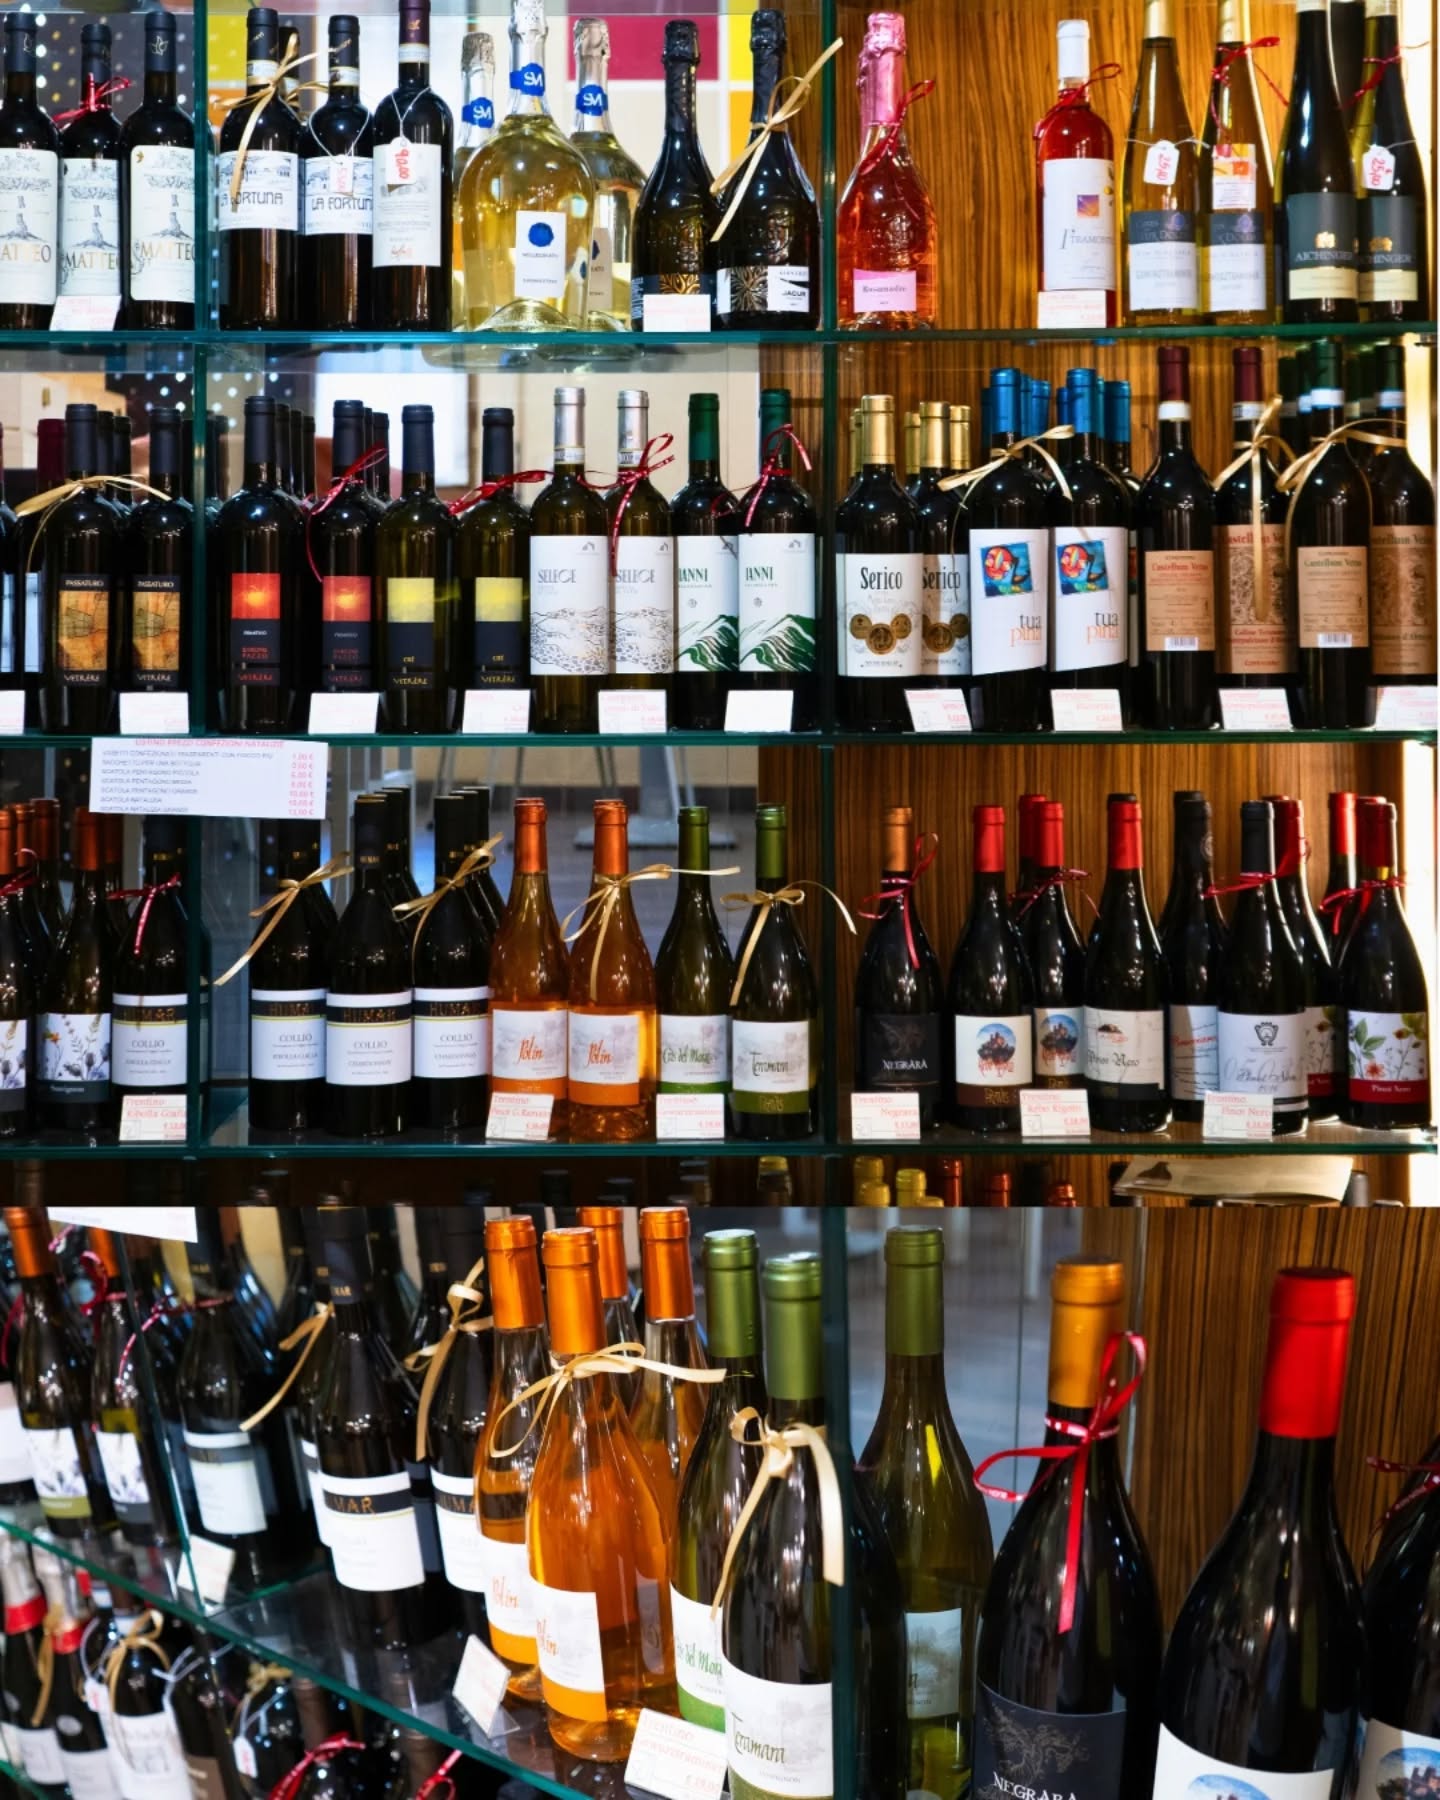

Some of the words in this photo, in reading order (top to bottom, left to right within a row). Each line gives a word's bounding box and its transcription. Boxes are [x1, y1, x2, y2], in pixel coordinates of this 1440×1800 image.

[231, 192, 283, 205] ORTUNA
[328, 197, 373, 210] FORTUN
[0, 245, 52, 263] ATTEO
[860, 567, 902, 590] Serico
